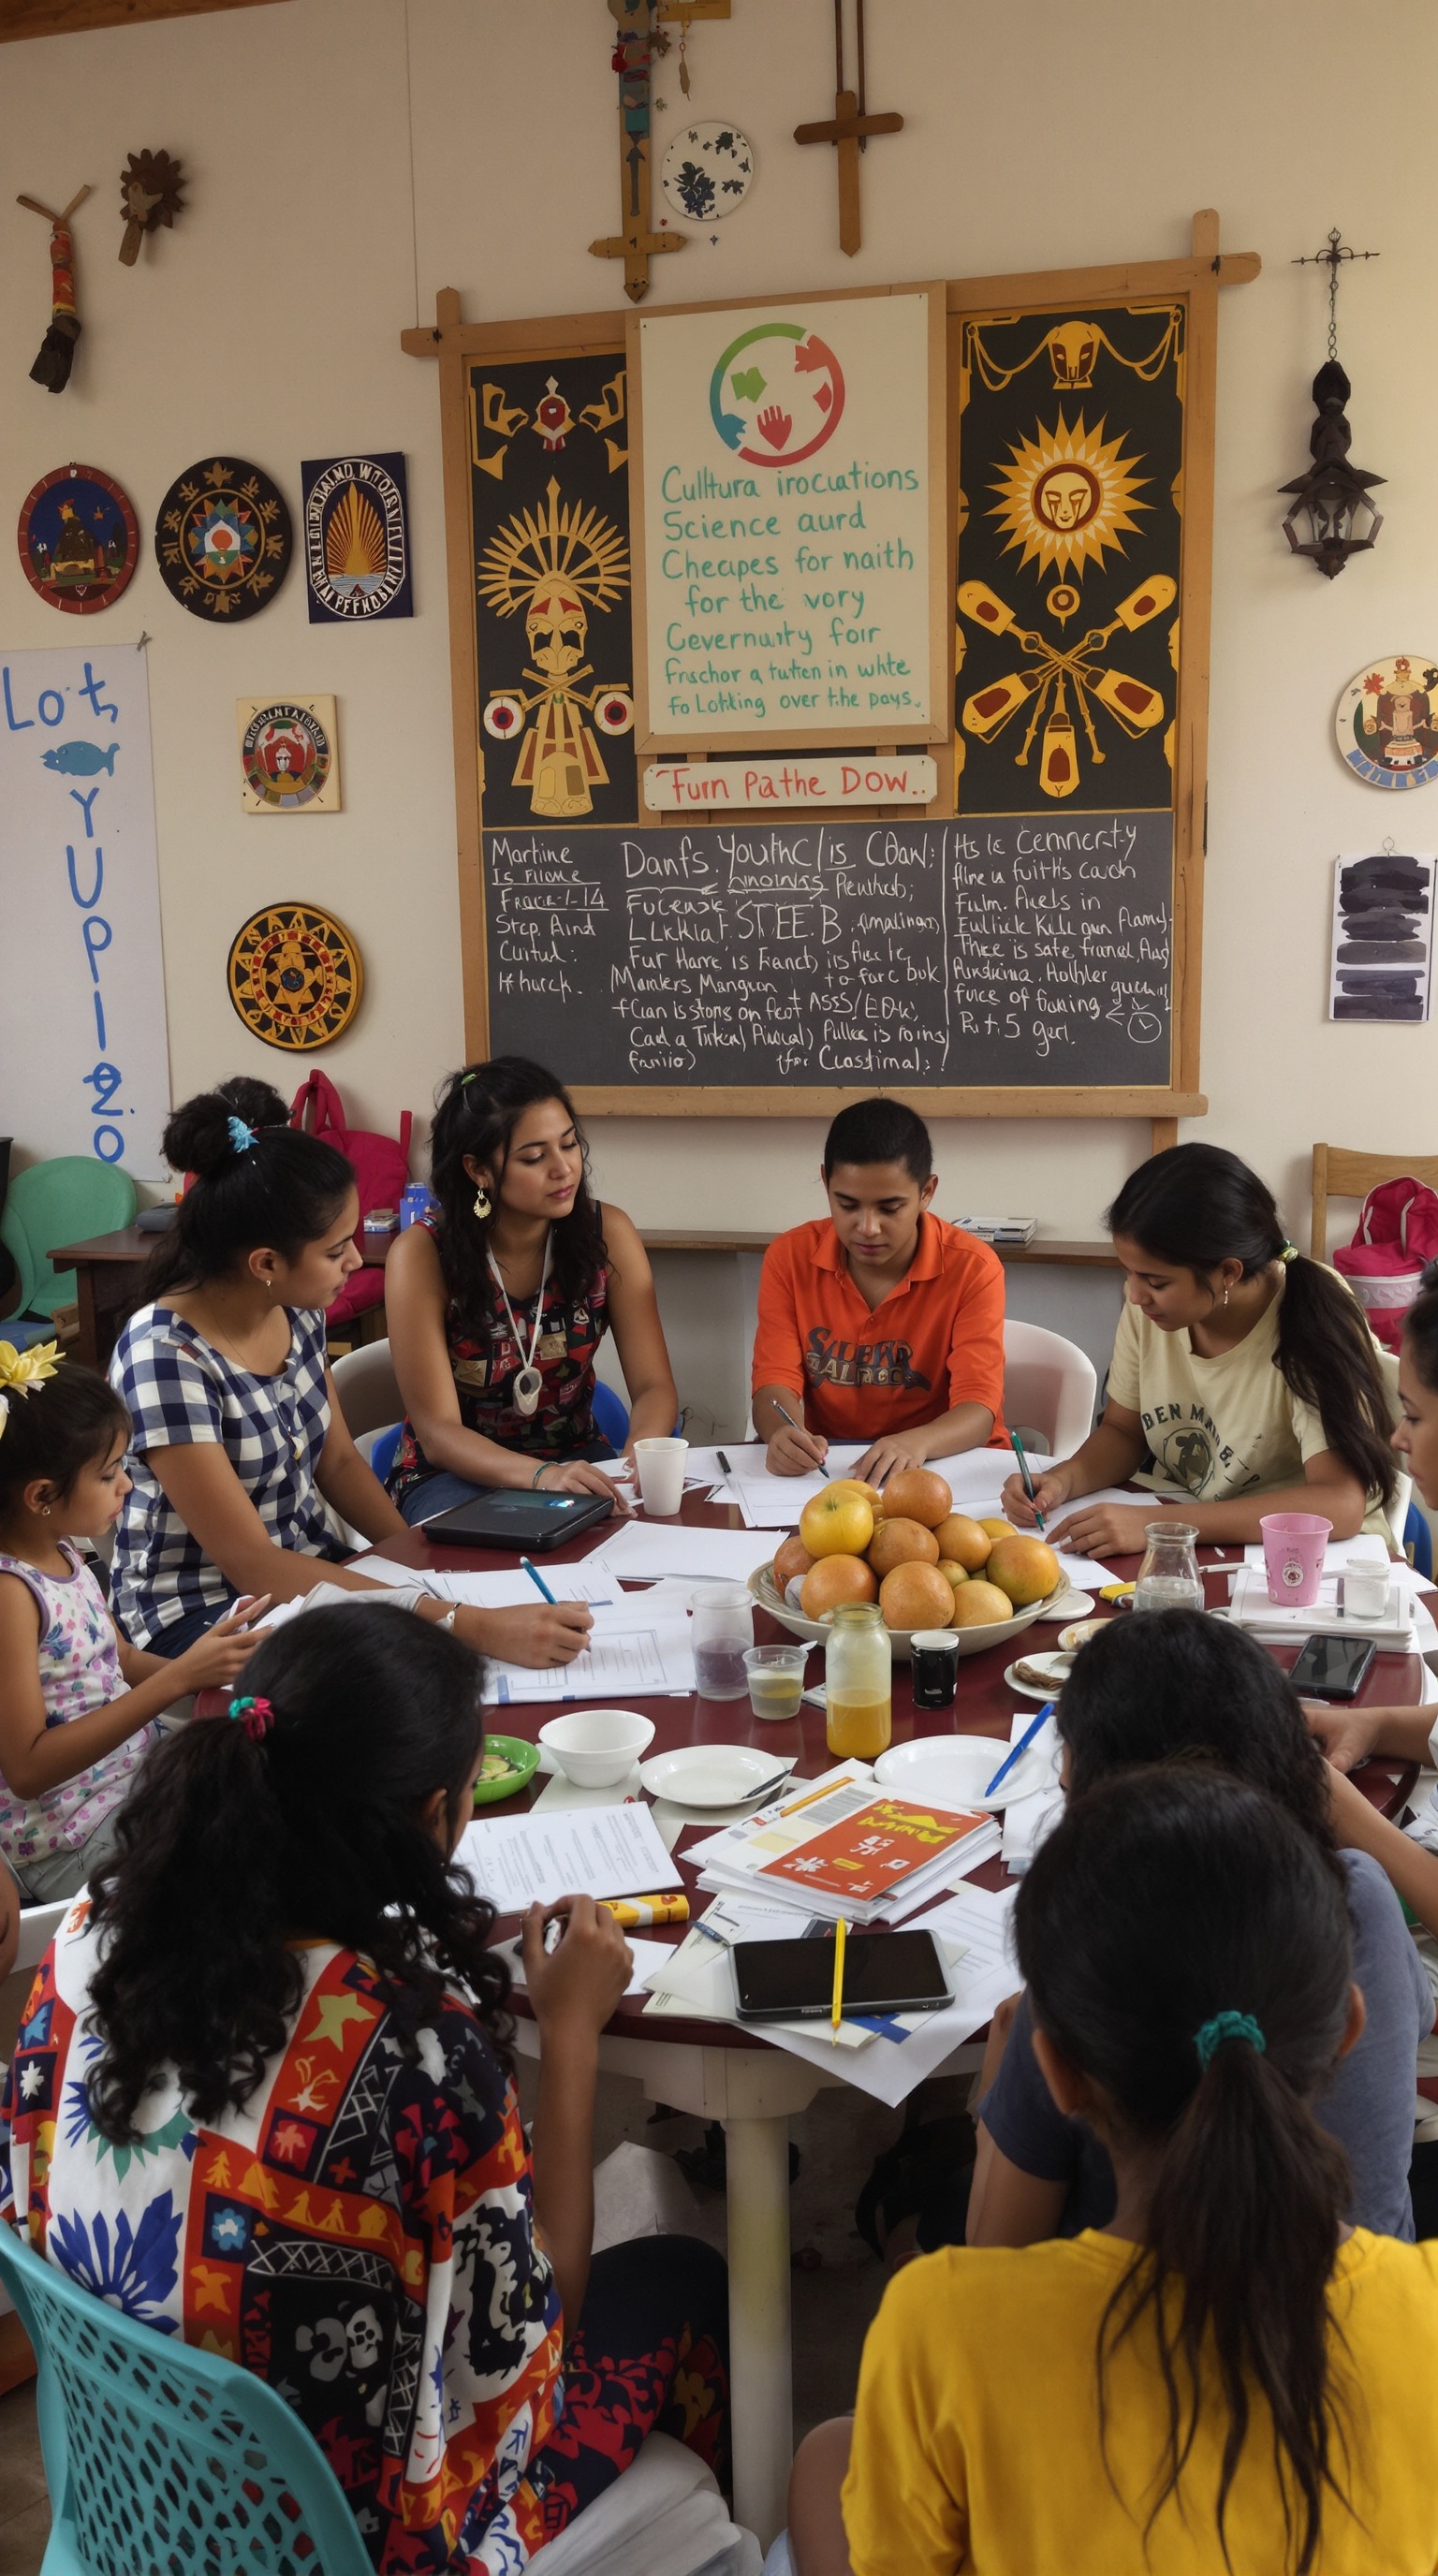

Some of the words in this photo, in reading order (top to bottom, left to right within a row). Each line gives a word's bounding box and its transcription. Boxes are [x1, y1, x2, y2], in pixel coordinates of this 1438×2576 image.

[663, 510, 781, 541] Science
[795, 546, 833, 574] for
[684, 584, 729, 617] for
[740, 582, 785, 612] the
[828, 659, 848, 679] in
[779, 694, 821, 710] over
[1079, 891, 1102, 911] in
[1009, 987, 1031, 1012] of
